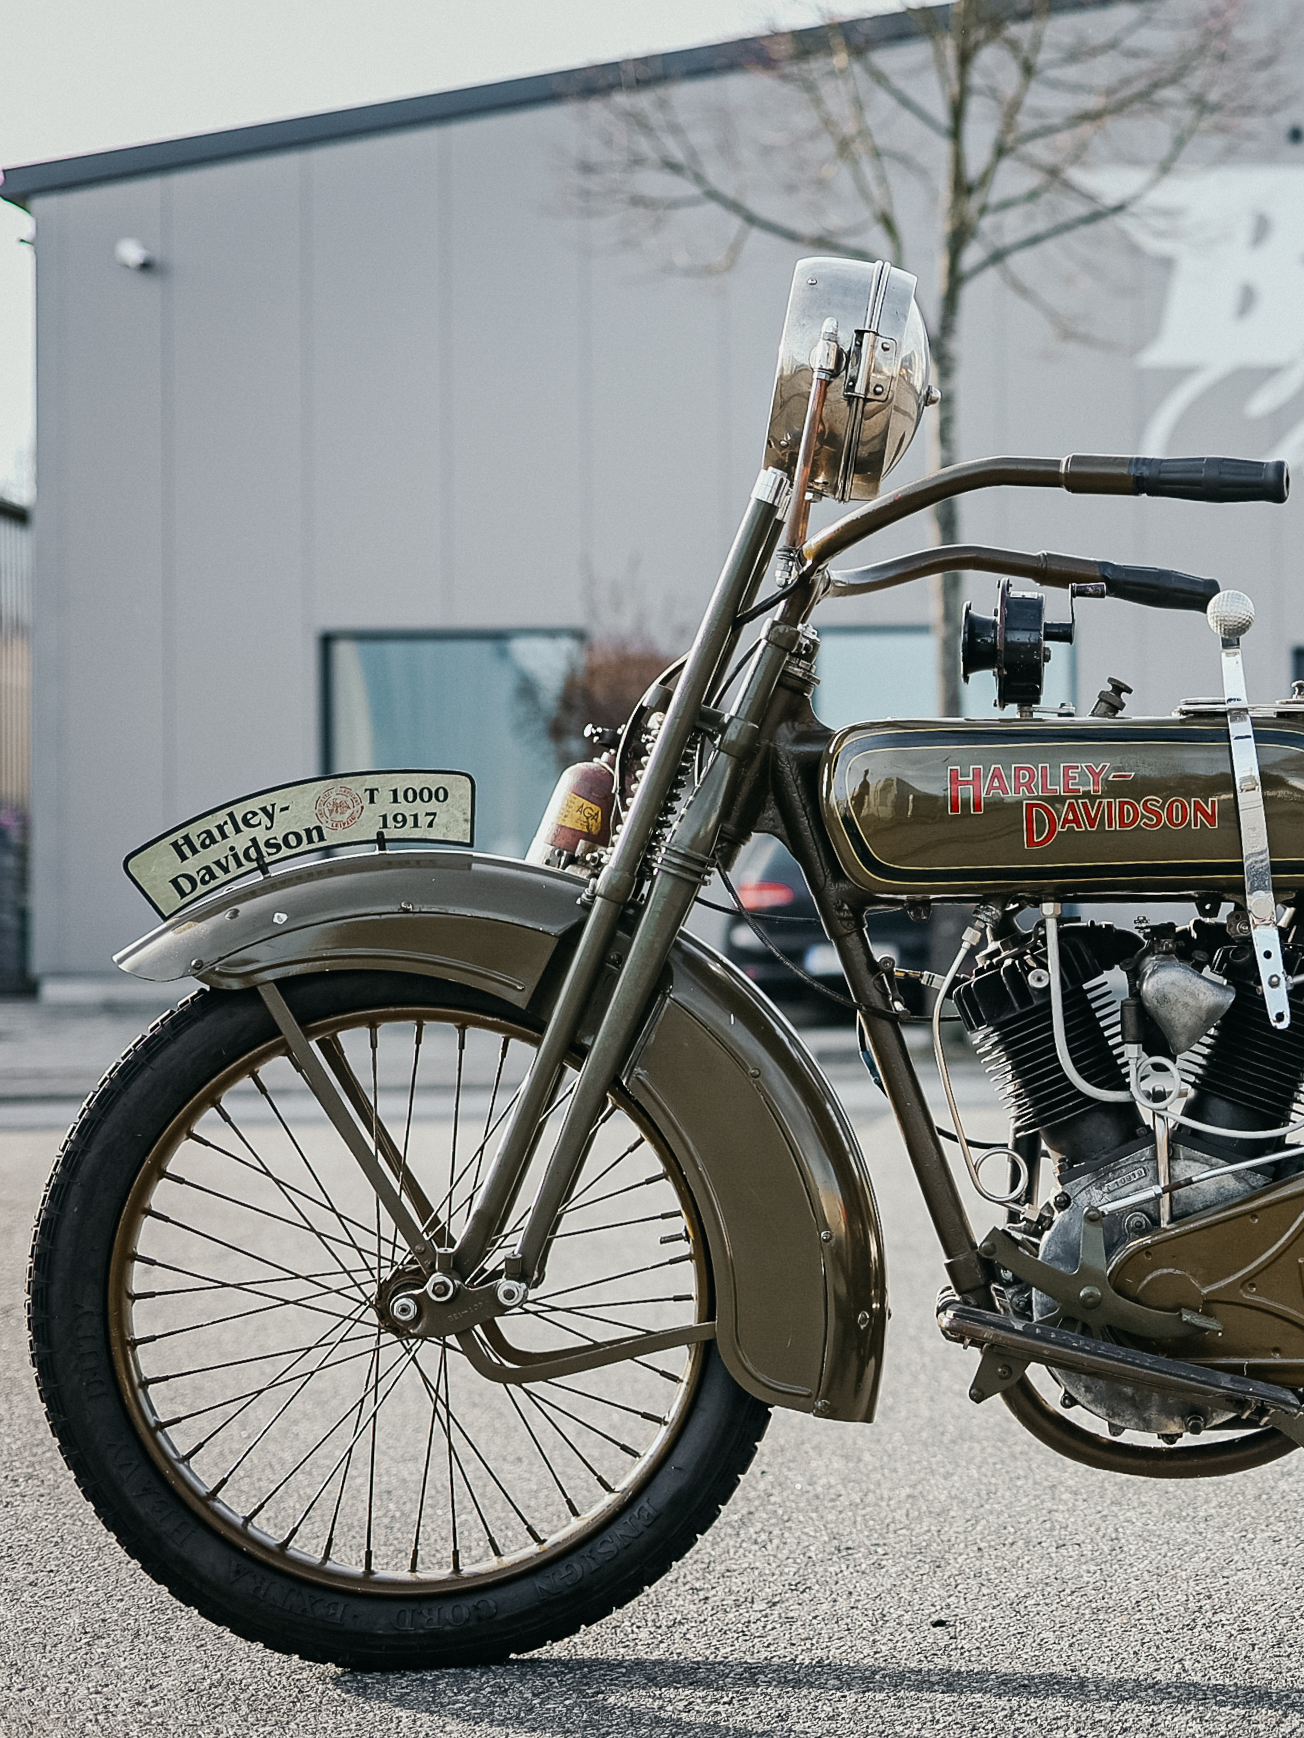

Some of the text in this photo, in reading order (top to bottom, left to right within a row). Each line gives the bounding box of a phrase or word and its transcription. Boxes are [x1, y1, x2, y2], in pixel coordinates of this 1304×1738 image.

[364, 787, 379, 805] T
[388, 786, 449, 804] 1000
[948, 763, 1135, 814] HARLEY-
[168, 801, 291, 864] Harley-
[378, 811, 437, 830] 1917
[1023, 795, 1218, 849] DAVIDSON
[168, 824, 327, 901] Davidson
[532, 1496, 663, 1601] ENSIGN
[389, 1597, 499, 1632] CORD
